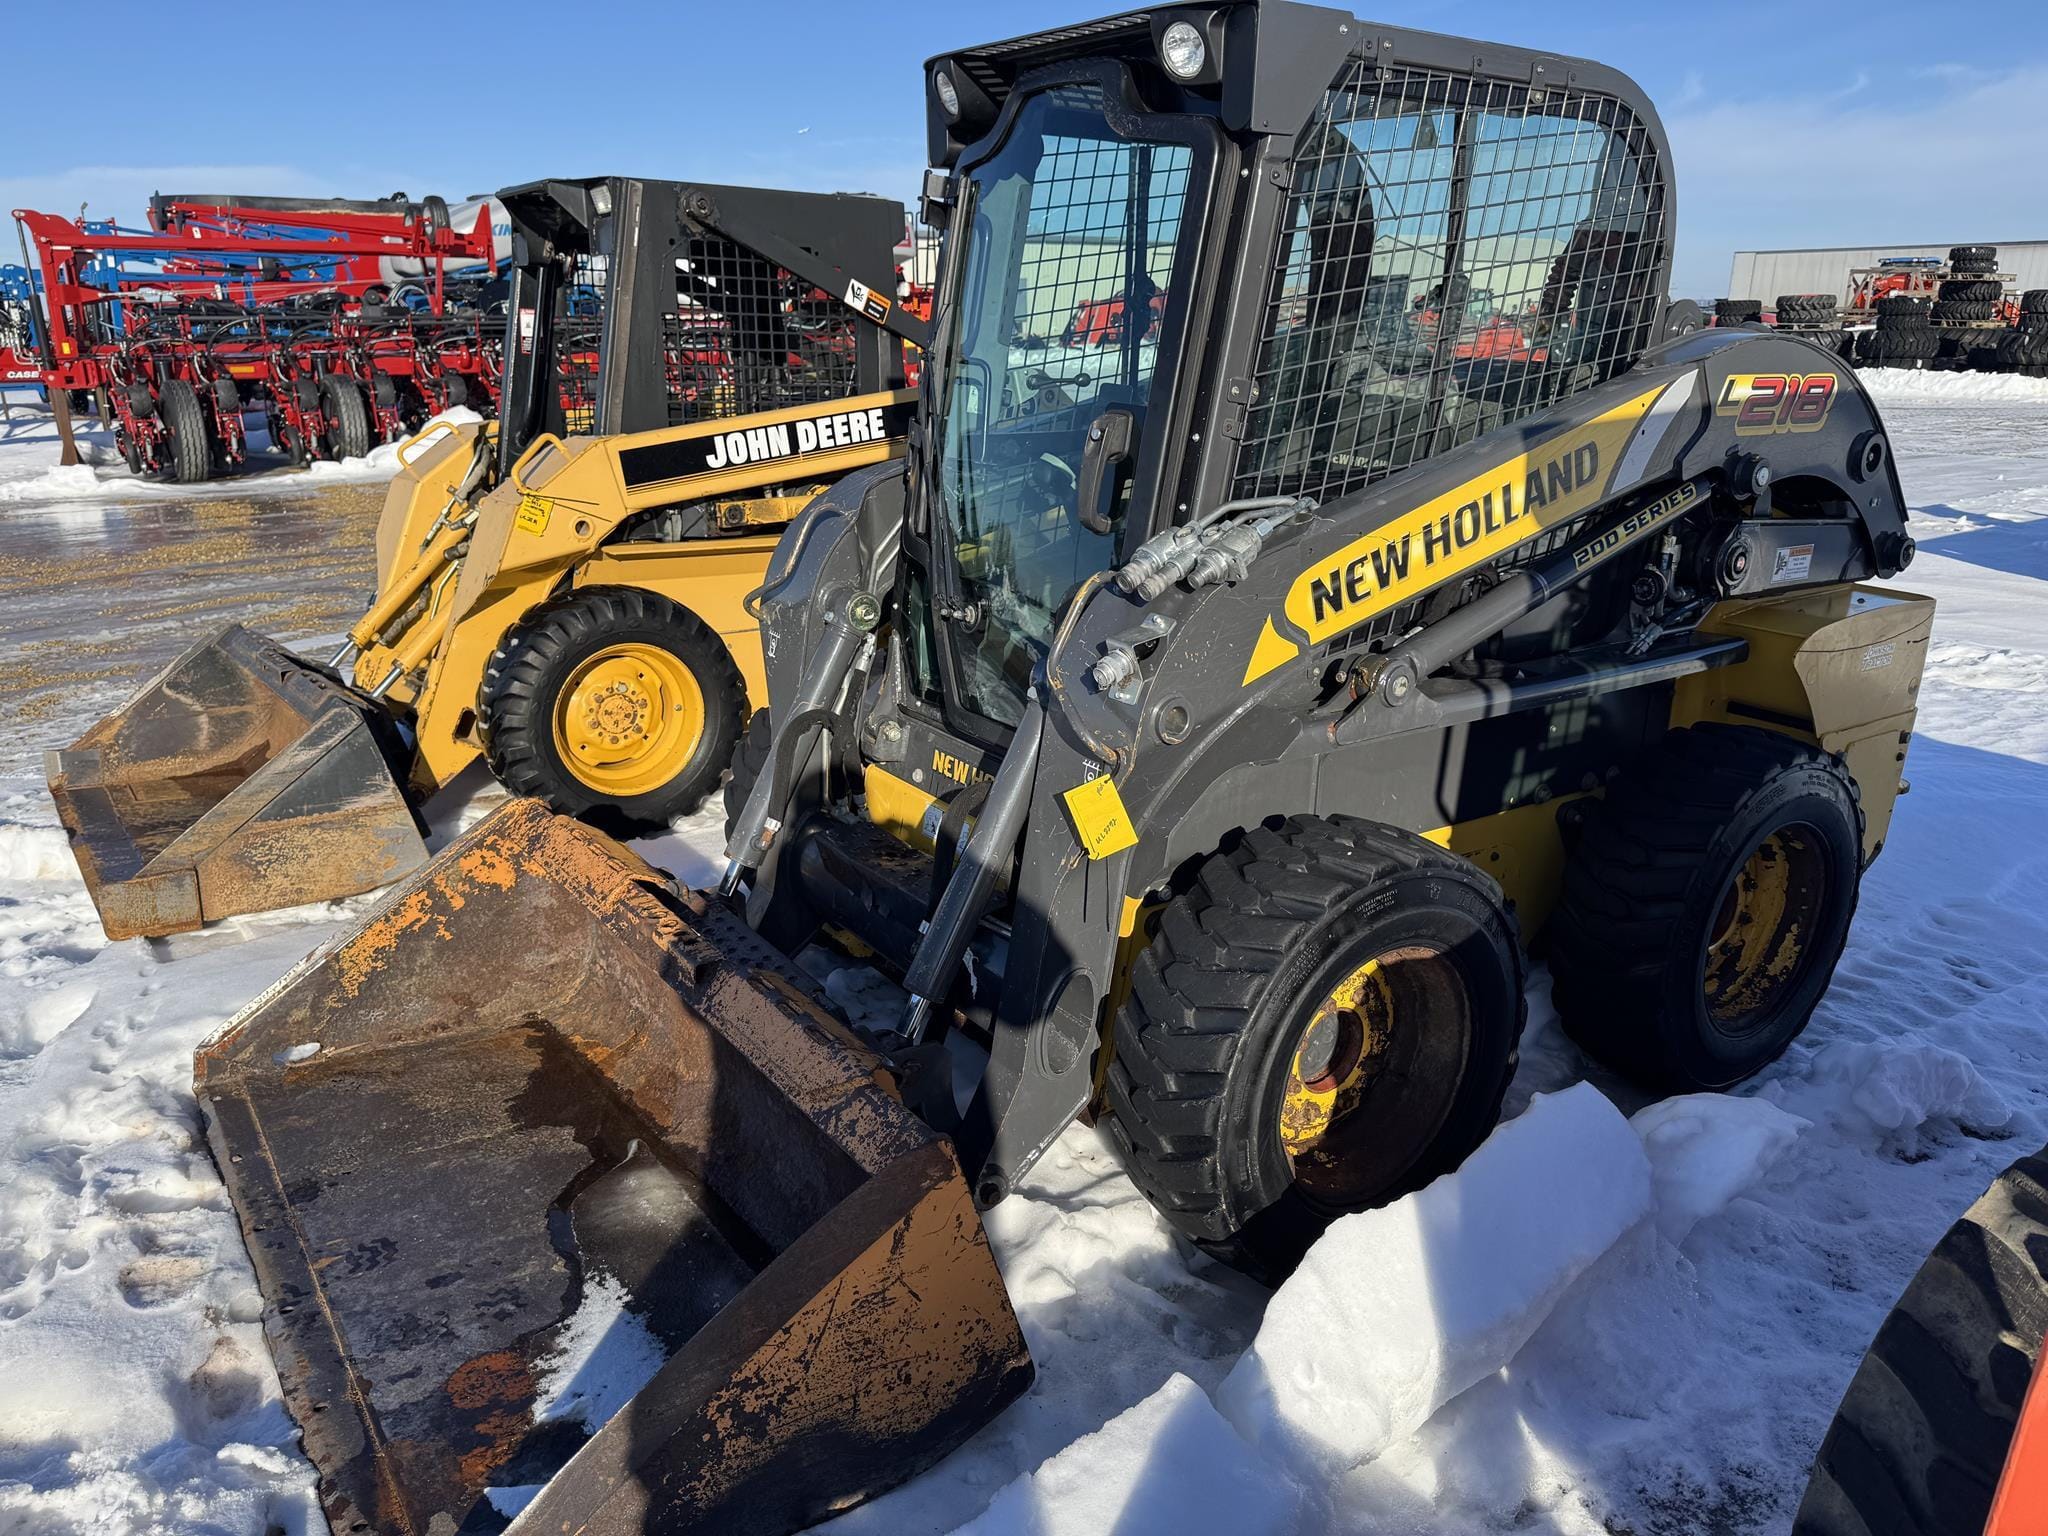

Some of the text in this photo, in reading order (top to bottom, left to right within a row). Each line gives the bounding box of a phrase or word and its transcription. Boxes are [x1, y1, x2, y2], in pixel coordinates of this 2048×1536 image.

[6, 371, 40, 379] CASE
[1718, 374, 1837, 433] L218
[706, 408, 886, 469] JOHN DEERE
[1310, 439, 1599, 624] NEW HOLLAND
[1575, 483, 1696, 567] 200 SERIES
[932, 749, 970, 785] NEW
